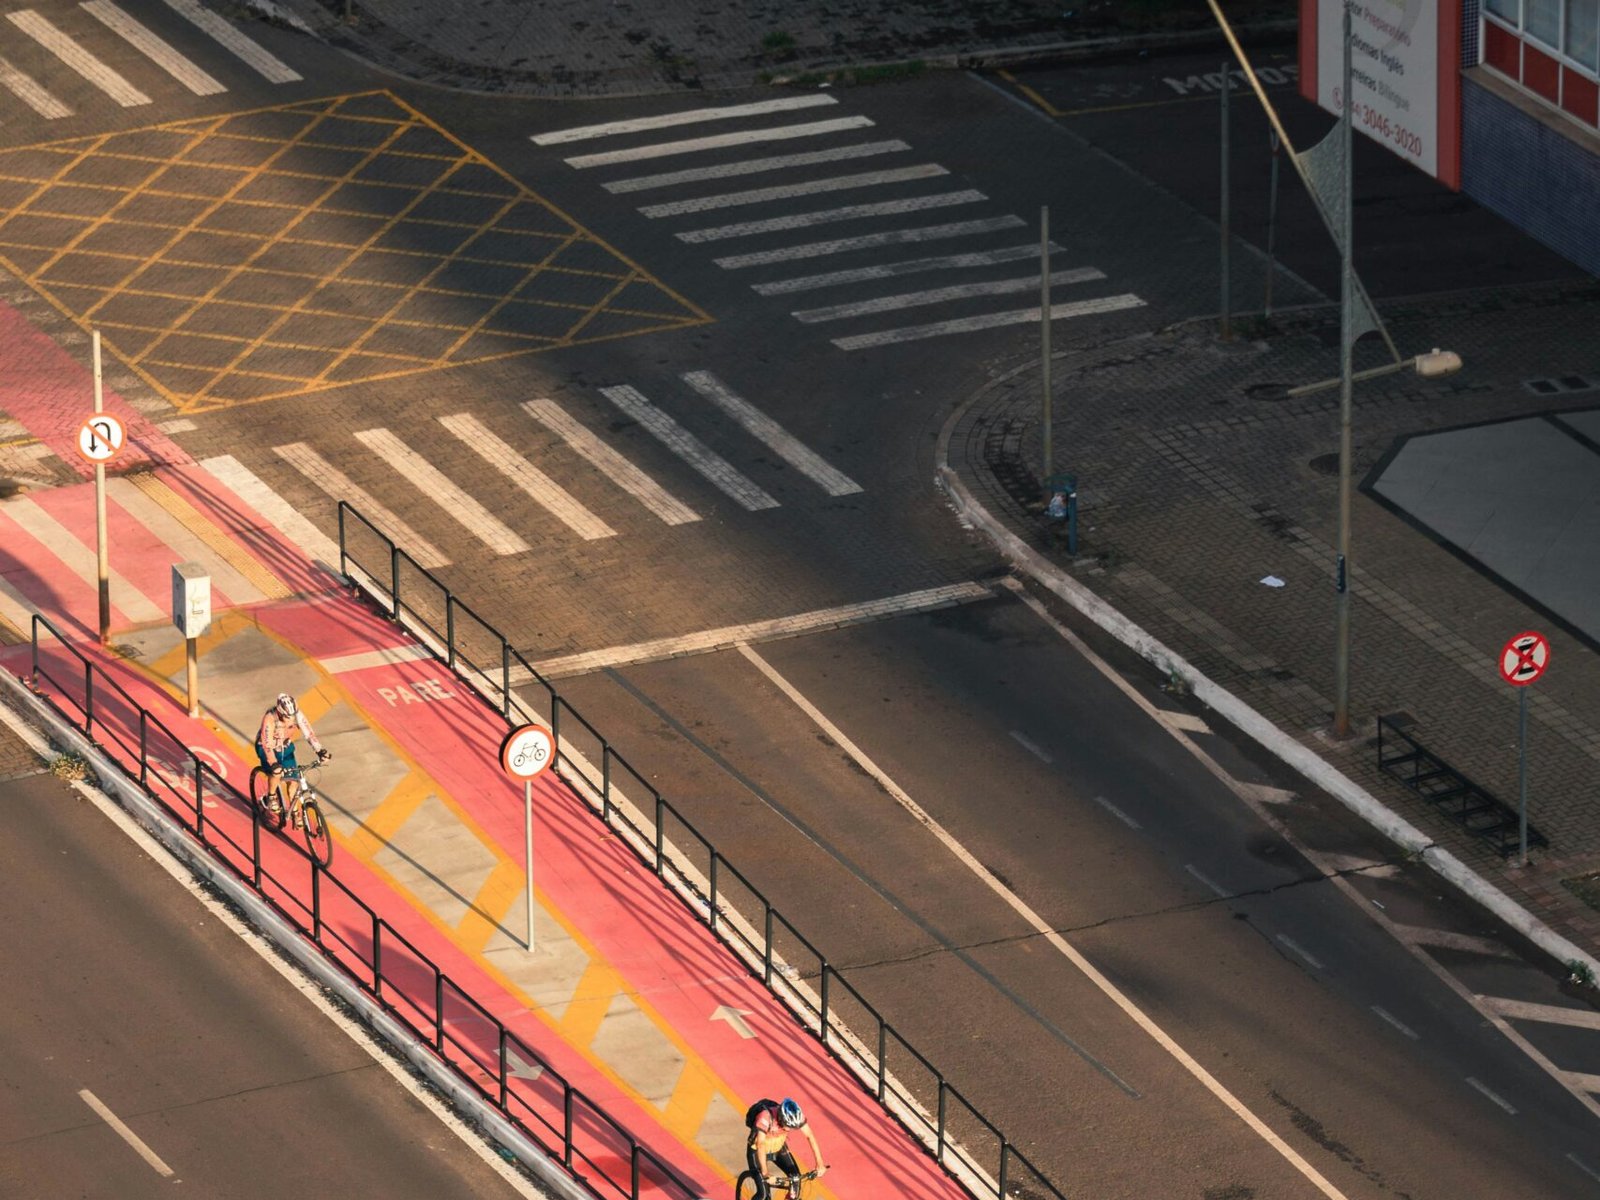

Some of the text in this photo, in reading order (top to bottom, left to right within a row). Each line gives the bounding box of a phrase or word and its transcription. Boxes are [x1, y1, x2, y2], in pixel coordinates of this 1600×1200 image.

[1351, 33, 1405, 76] diomas Inglês
[1362, 104, 1422, 156] 3046-3020
[376, 679, 456, 708] PARE
